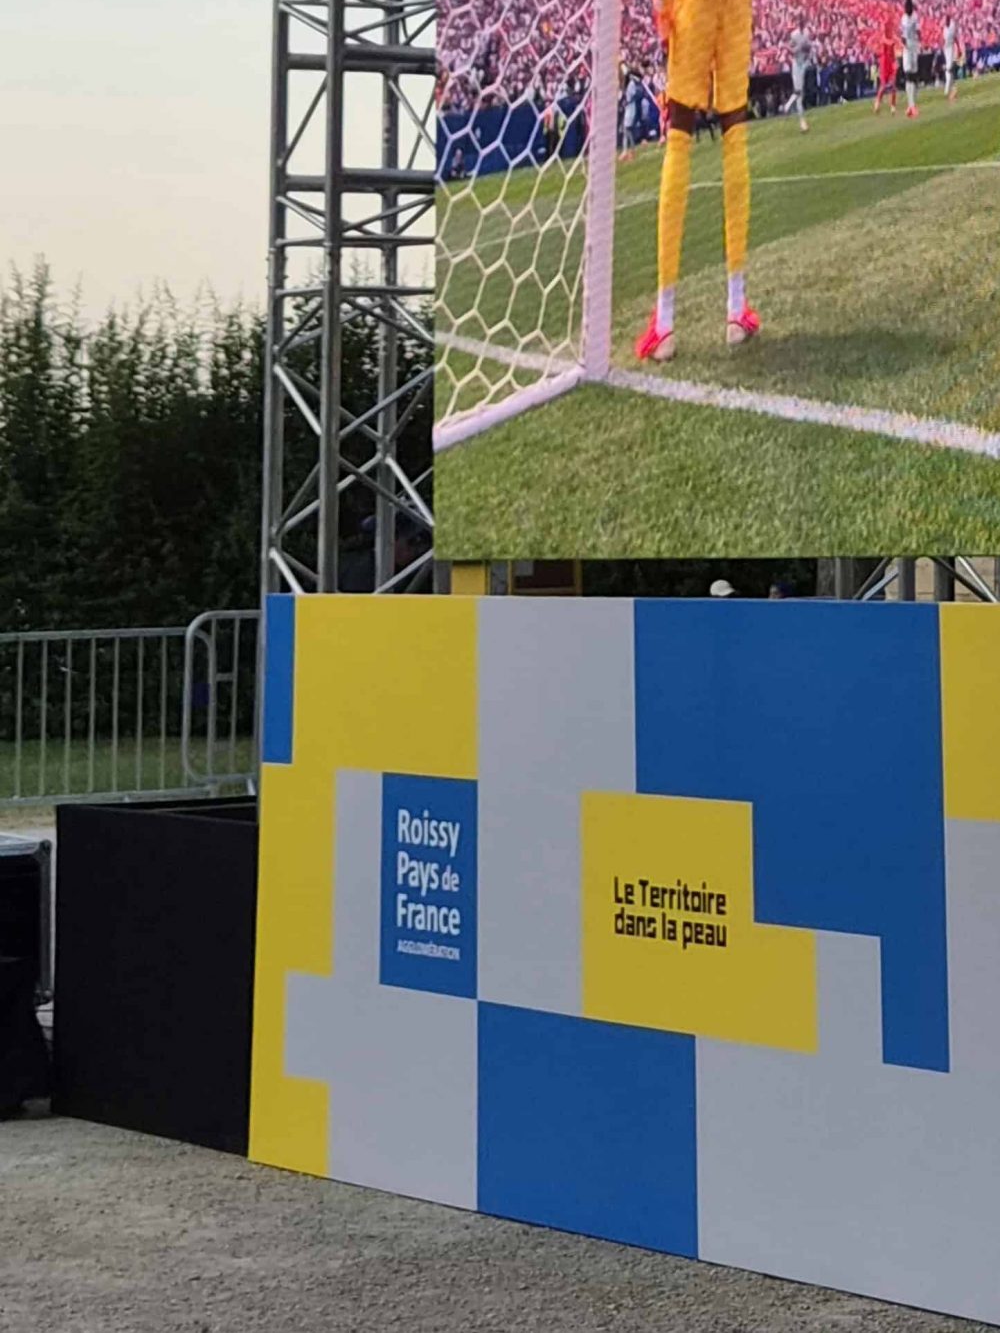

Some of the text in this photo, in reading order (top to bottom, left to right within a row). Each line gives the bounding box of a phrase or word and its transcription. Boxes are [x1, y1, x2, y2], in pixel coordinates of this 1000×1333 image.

[397, 808, 461, 857] Roissy
[396, 850, 460, 897] Pays de
[396, 893, 461, 936] France
[613, 876, 727, 916] Le Territoire
[614, 907, 727, 949] dans la peau
